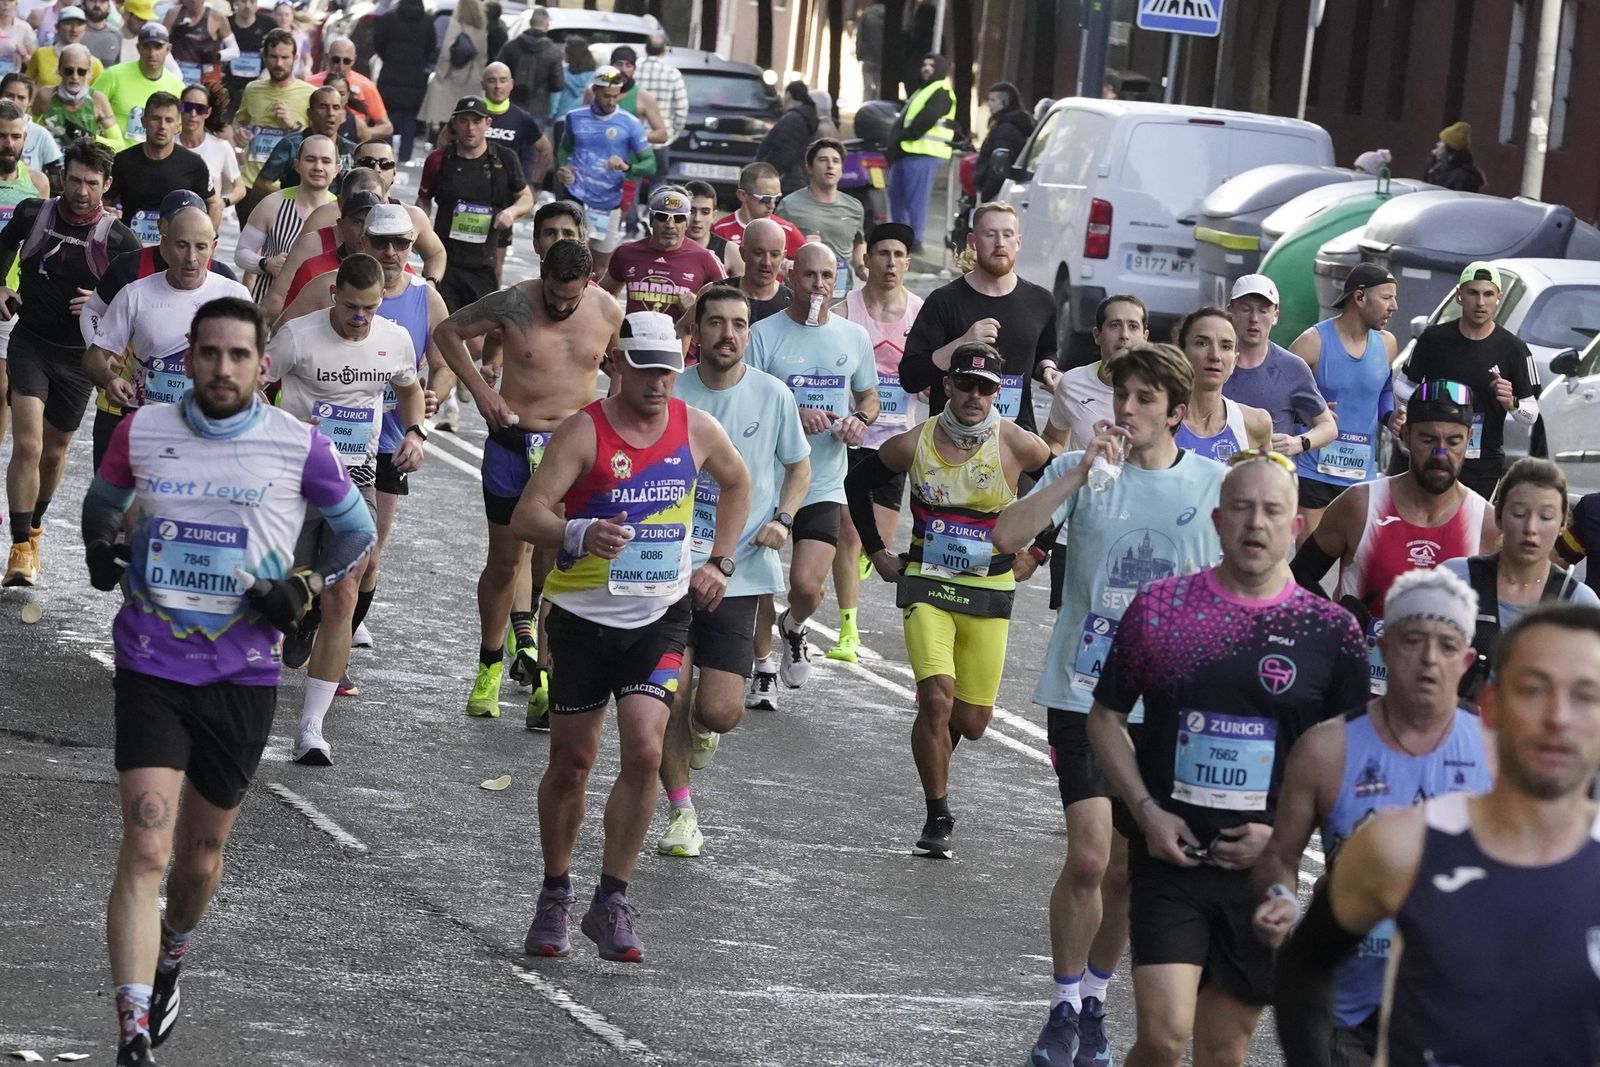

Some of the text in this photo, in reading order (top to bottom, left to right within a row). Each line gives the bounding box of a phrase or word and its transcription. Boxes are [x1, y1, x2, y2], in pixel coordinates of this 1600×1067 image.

[1135, 256, 1166, 270] 9177
[168, 380, 185, 389] 9371
[808, 378, 839, 386] ZURICH
[145, 390, 175, 403] MIGUEL
[807, 393, 824, 401] 5929
[336, 410, 368, 419] ZURICH
[333, 427, 353, 436] 8868
[334, 442, 367, 453] MANUEL
[1340, 447, 1355, 455] 6277
[1323, 454, 1364, 468] ANTONIO
[146, 478, 267, 504] Next Level
[611, 486, 686, 503] PALACIEGO
[694, 509, 713, 521] 7651
[183, 527, 237, 544] ZURICH
[641, 528, 680, 539] ZURICH
[948, 525, 987, 539] ZURICH
[640, 550, 663, 560] 8086
[947, 543, 967, 554] 6048
[183, 552, 211, 567] 7845
[943, 554, 970, 569] VITO
[610, 569, 643, 581] FRANK
[928, 590, 970, 605] HANKER
[621, 683, 666, 699] PALACIEGO
[1210, 719, 1264, 735] ZURICH
[1209, 747, 1238, 762] 7662
[1195, 763, 1247, 786] TILUD
